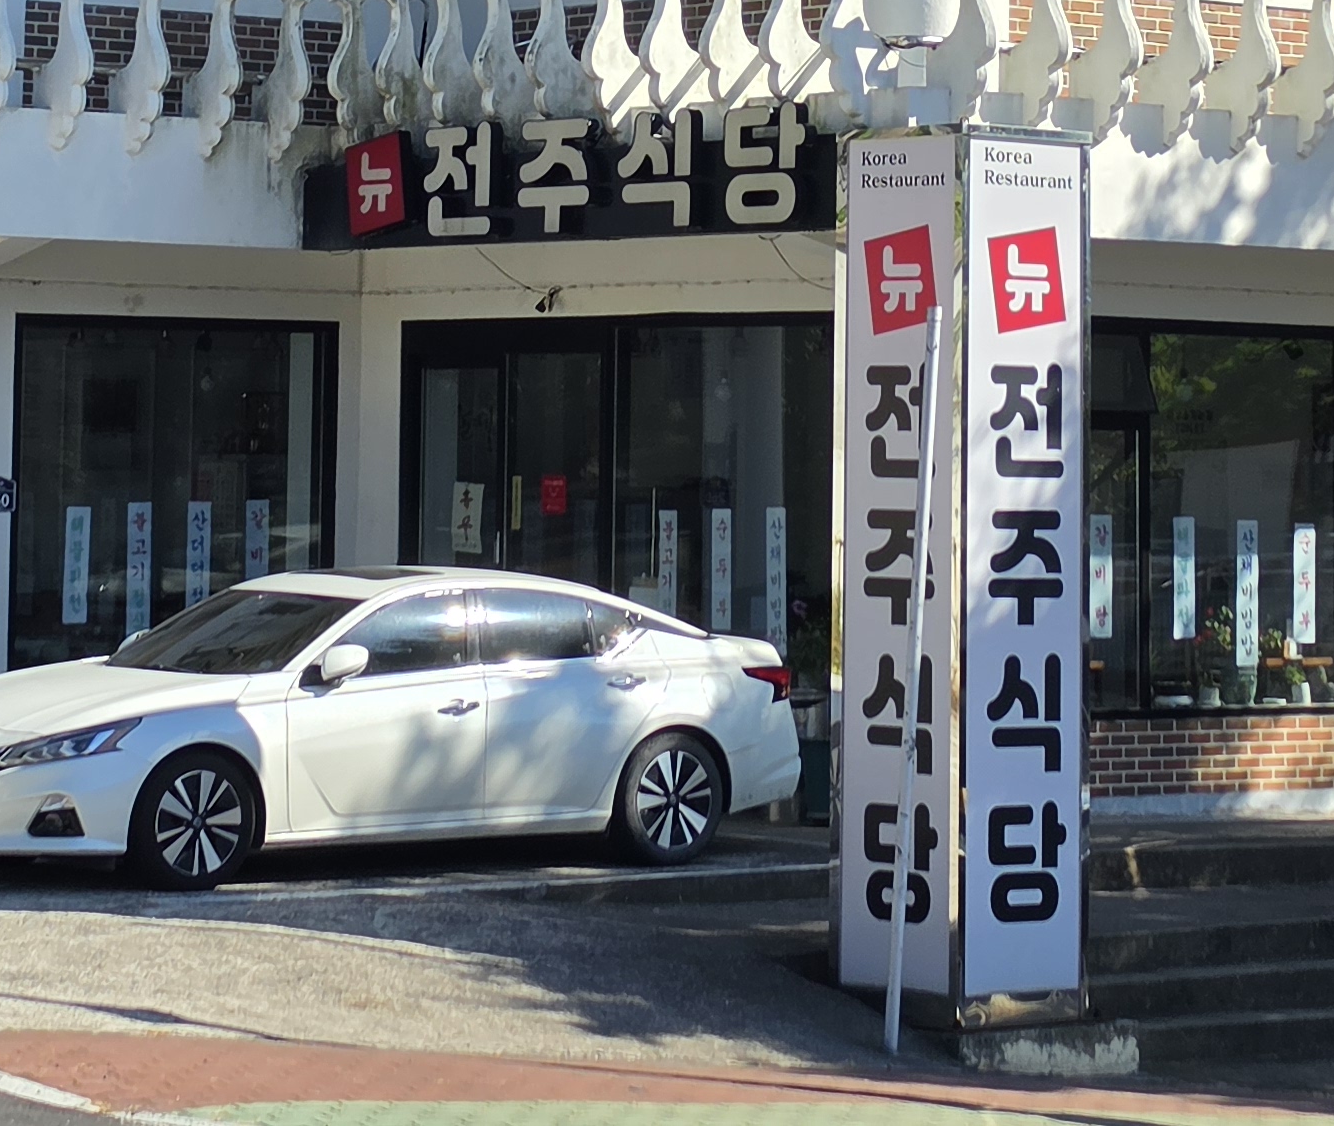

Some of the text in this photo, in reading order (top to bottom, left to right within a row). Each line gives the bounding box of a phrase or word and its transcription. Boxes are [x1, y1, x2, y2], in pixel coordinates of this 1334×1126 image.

[359, 100, 806, 237] 뉴 전주식당
[860, 150, 908, 167] Korea
[860, 172, 946, 189] Restaurant
[983, 146, 1033, 165] Korea
[983, 169, 1074, 191] Restaurant
[715, 517, 729, 618] 순두부
[862, 244, 939, 924] 뉴 전주식당
[986, 243, 1067, 923] 뉴 전주식당
[1240, 528, 1255, 657] 산채비빔밥
[1298, 532, 1311, 632] 순두부
